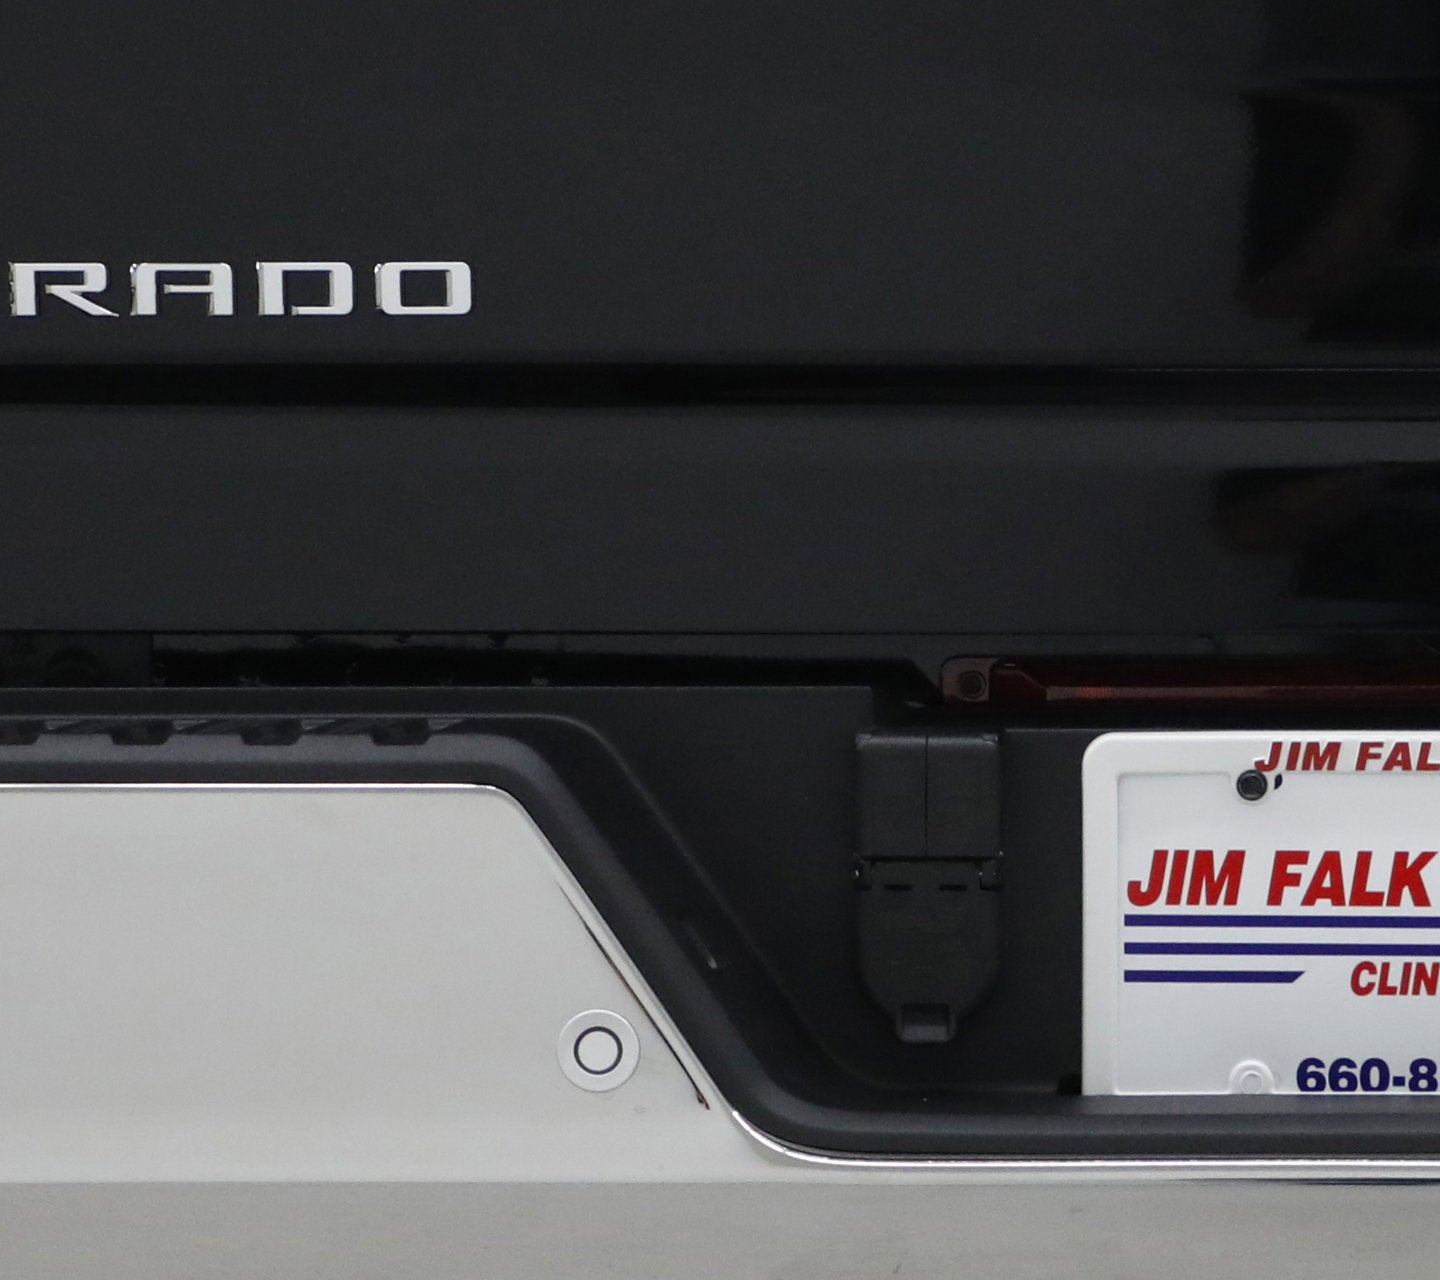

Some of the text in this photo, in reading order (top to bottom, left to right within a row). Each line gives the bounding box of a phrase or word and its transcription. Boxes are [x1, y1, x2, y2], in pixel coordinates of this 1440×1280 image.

[1254, 740, 1341, 773] JIM
[1126, 849, 1247, 907] JIM
[1267, 850, 1437, 908] FALK
